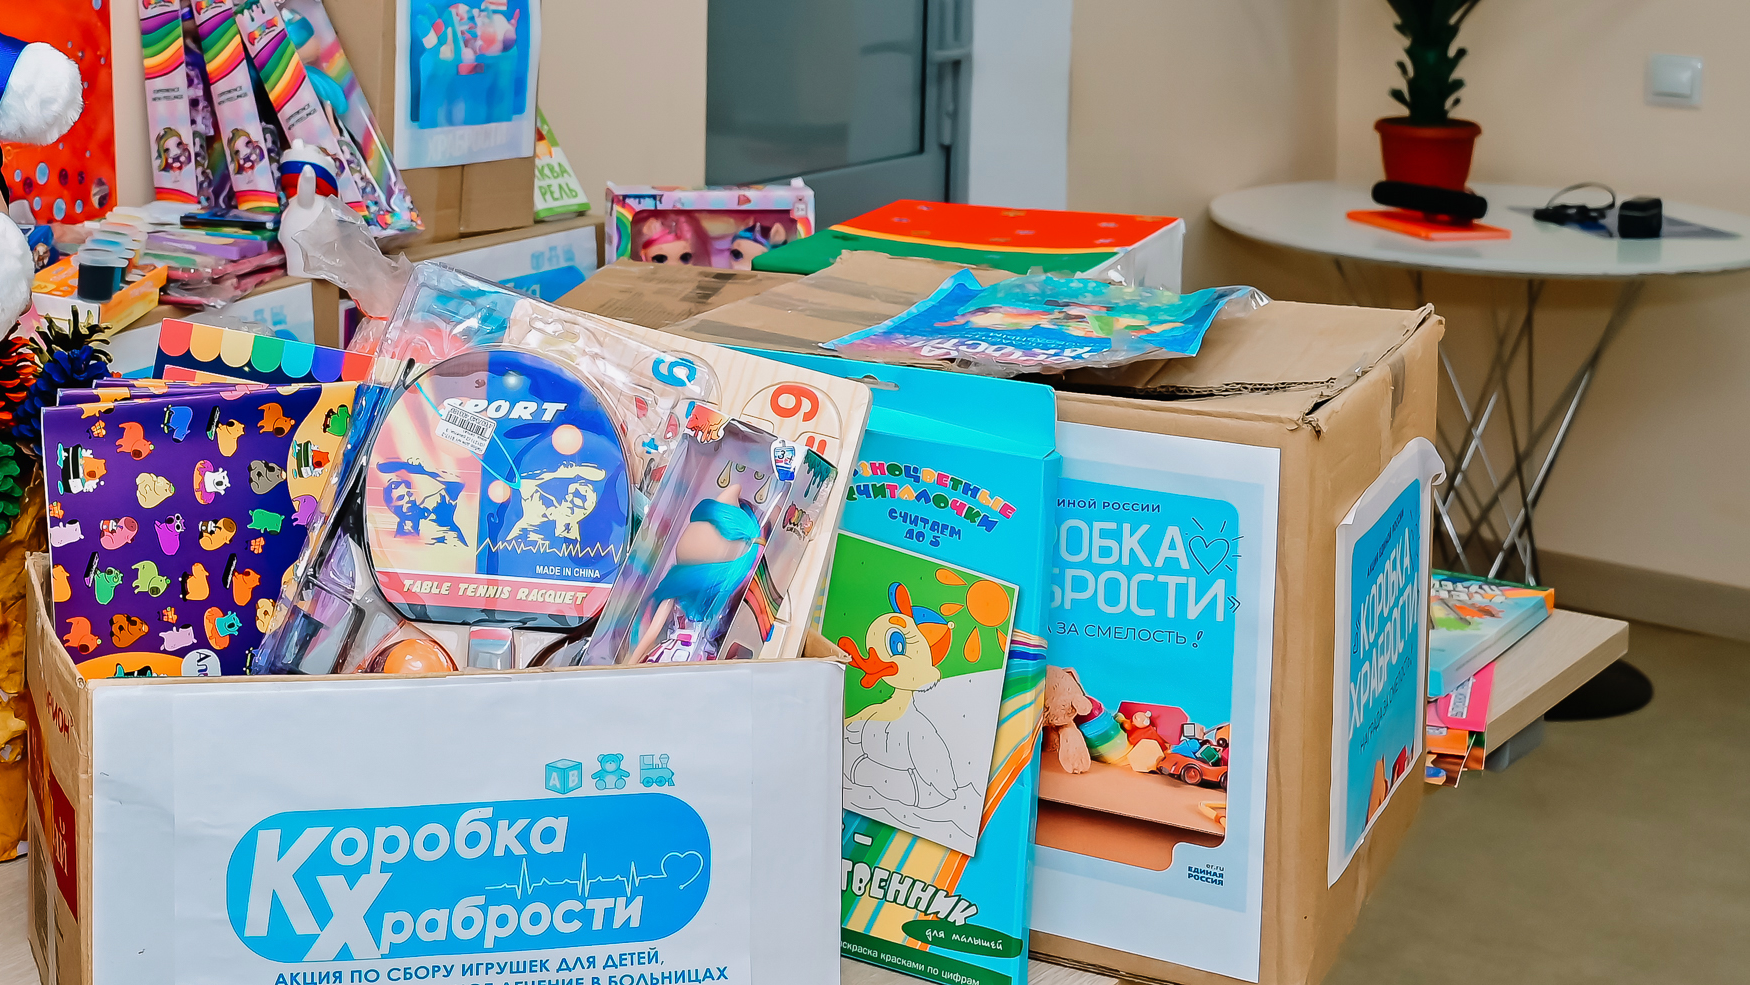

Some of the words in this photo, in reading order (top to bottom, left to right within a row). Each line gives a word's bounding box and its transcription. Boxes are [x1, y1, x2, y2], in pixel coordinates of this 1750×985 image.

[539, 182, 579, 203] РЕЛЬ
[443, 398, 567, 422] SPORT
[853, 461, 1017, 519] ЗНОЦВЕТНЫЕ
[1102, 500, 1161, 513] РОССИИ
[888, 508, 962, 541] СЧИТАЕМ
[904, 528, 926, 543] ДО
[929, 536, 941, 548] 5
[1054, 519, 1190, 569] ОБКА
[536, 565, 561, 575] MADE
[563, 566, 572, 576] IN
[574, 567, 600, 578] CHINA
[403, 579, 451, 595] TABLE
[458, 583, 512, 599] TENNIS
[516, 587, 588, 605] RACQUET
[1056, 622, 1079, 636] ЗА
[244, 807, 569, 937] Коробка
[1188, 866, 1224, 879] ЕДИНАЯ
[1188, 873, 1224, 886] РОССИЯ
[301, 872, 643, 961] Храбрости
[925, 928, 945, 941] для
[951, 932, 1003, 951] малышей
[274, 969, 343, 985] АКЦИЯ
[350, 968, 380, 984] ПО
[387, 964, 455, 981] СБОРУ
[462, 959, 550, 977] ИГРУШЕК
[556, 955, 596, 973] ДЛЯ
[602, 946, 665, 970] ДЕТЕЙ,
[608, 966, 728, 985] БОЛЬНИЦАХ
[880, 952, 925, 971] красками
[927, 965, 939, 976] по
[941, 970, 981, 985] цифрам
